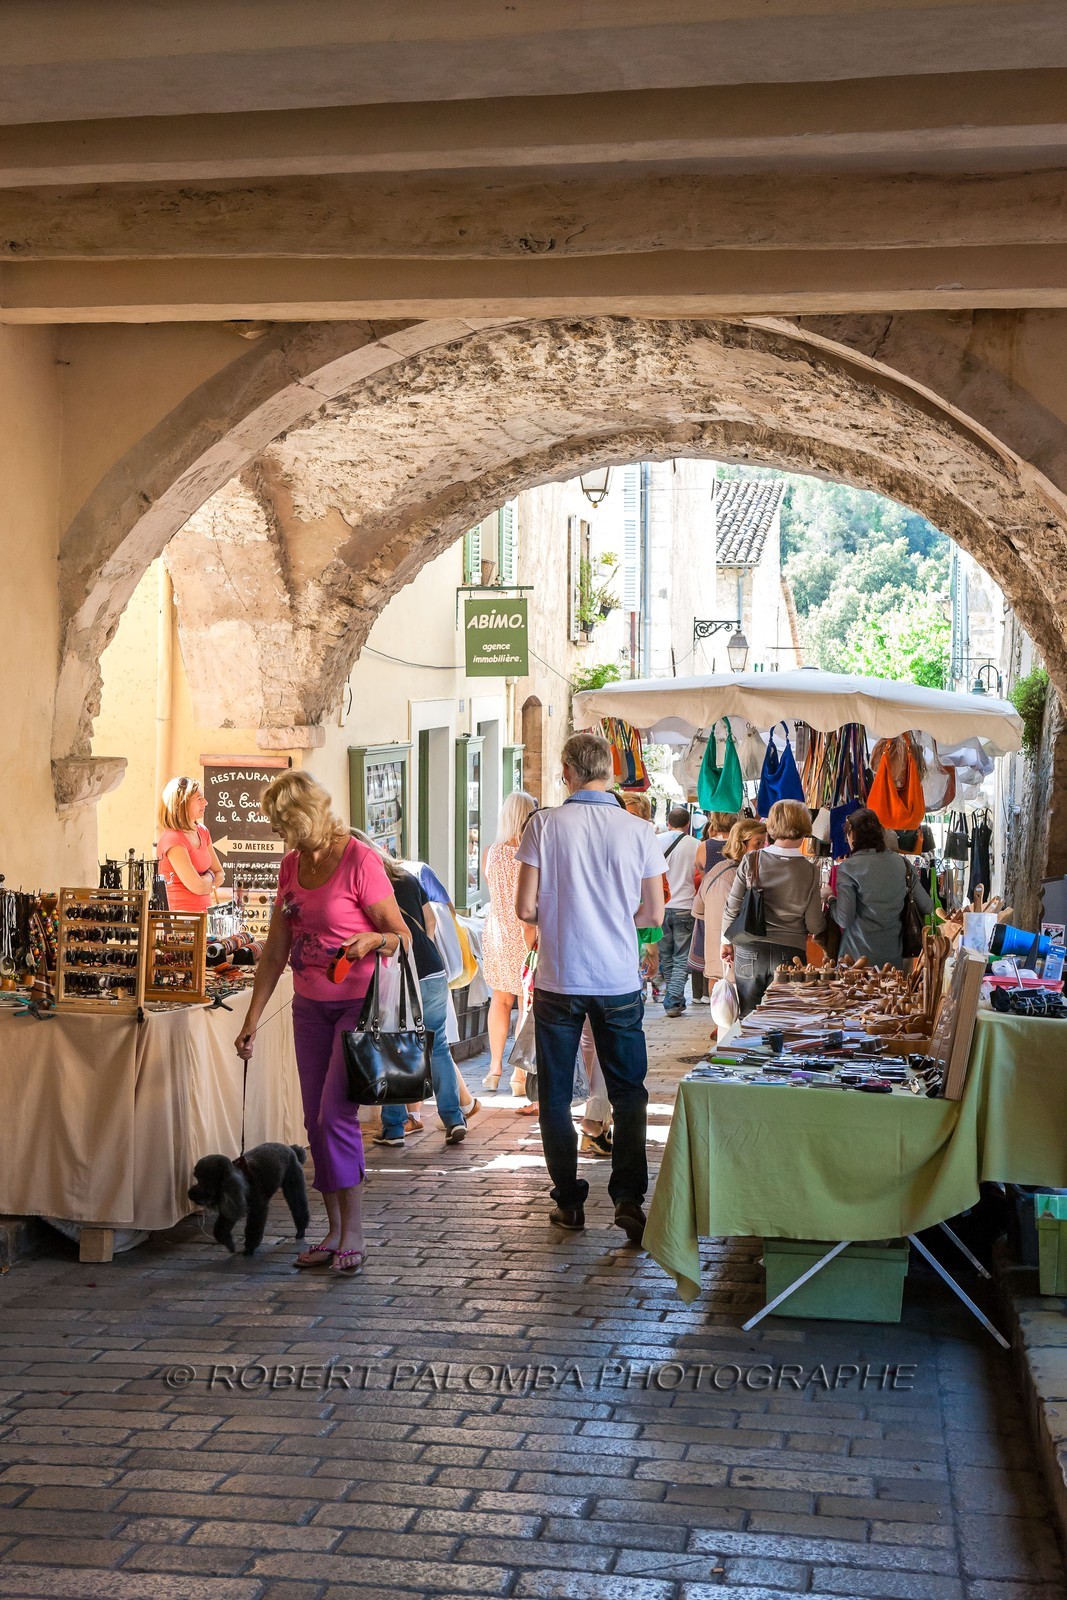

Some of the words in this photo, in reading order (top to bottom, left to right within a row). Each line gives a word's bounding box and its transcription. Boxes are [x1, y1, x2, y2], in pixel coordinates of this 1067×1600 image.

[482, 643, 510, 652] agence
[473, 653, 522, 663] immobilière.
[210, 772, 276, 784] RESTAURAN
[217, 791, 235, 808] Le
[215, 811, 228, 822] de
[231, 811, 242, 822] la
[246, 811, 271, 823] Rue
[232, 842, 243, 850] 30
[245, 843, 275, 851] METRES
